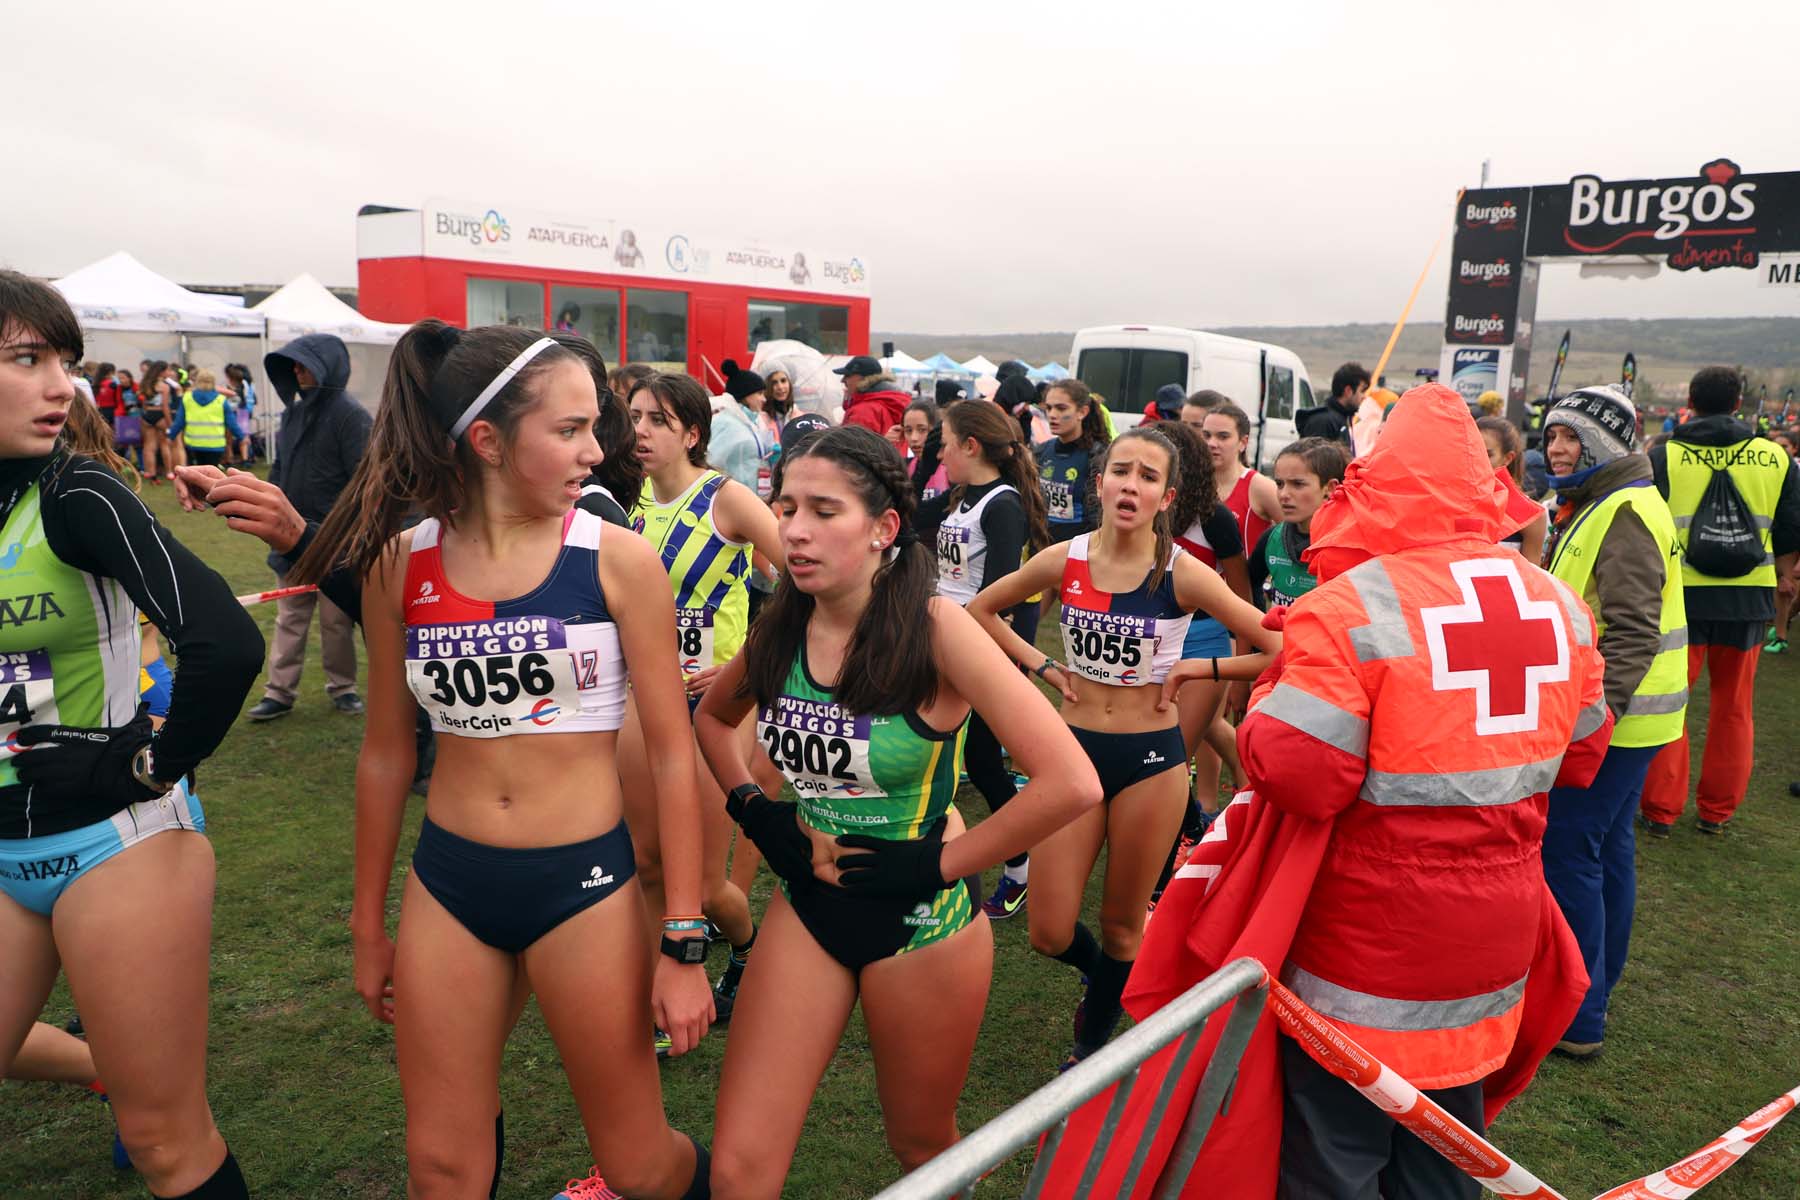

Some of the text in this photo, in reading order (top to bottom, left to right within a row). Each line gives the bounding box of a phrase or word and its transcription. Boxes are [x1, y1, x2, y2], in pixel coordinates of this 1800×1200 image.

[1466, 204, 1517, 224] Burgos
[1568, 177, 1756, 240] Burgos
[1460, 260, 1511, 280] Burgos
[1455, 314, 1505, 335] Burgos
[1680, 449, 1780, 468] ATAPUERCA
[1066, 615, 1144, 637] BURGOS
[1068, 607, 1145, 627] DIPUTACIÓN
[417, 617, 548, 642] DIPUTACIÓN
[417, 633, 550, 659] BURGOS
[1069, 628, 1142, 667] 3055
[423, 652, 555, 707] 3056
[439, 711, 512, 732] iberCaja
[763, 725, 858, 782] 2902
[812, 806, 889, 825] RURAL GALEGA
[18, 854, 81, 881] HAZA
[581, 874, 614, 889] VIATOR
[904, 916, 941, 926] VIATOR
